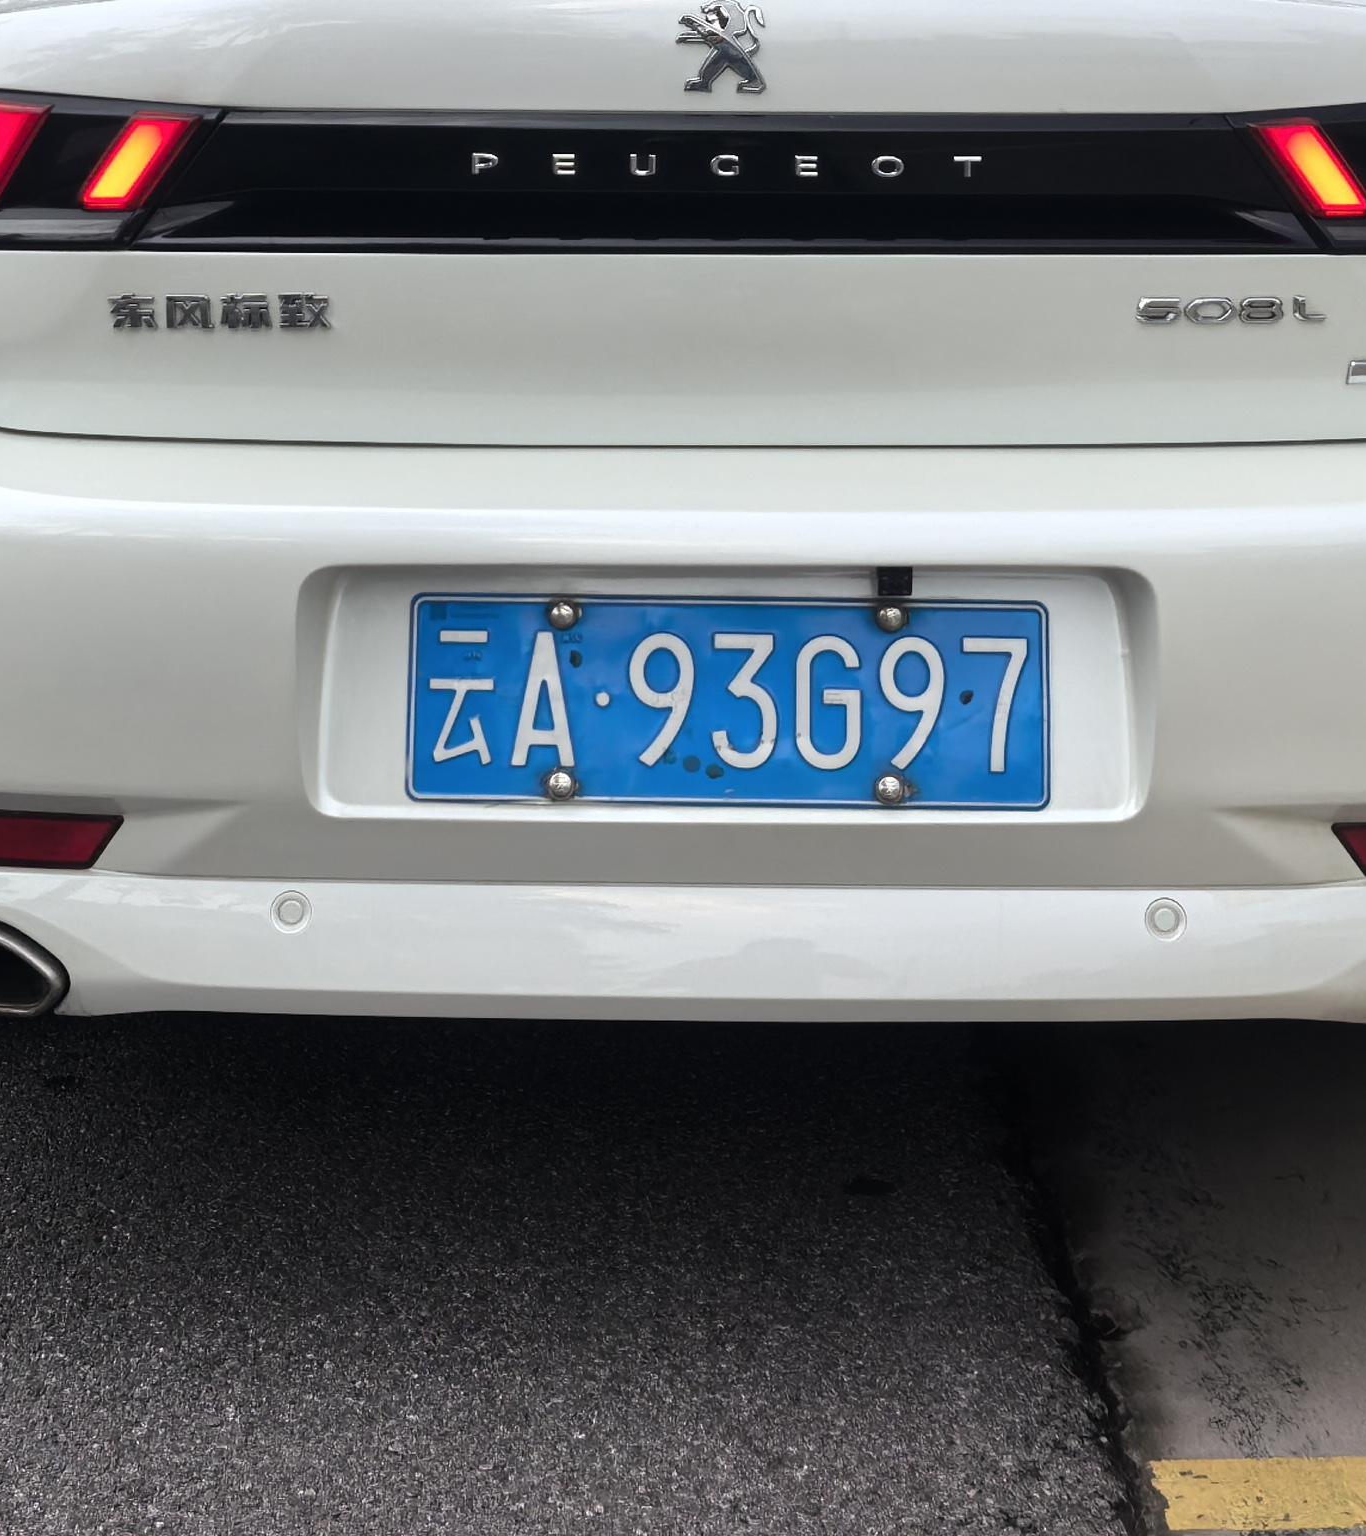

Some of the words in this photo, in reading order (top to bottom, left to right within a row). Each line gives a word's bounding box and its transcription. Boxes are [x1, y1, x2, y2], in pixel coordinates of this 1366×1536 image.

[470, 152, 982, 178] PEUGEOT
[107, 292, 333, 329] 东风标致
[1135, 295, 1327, 324] 508L
